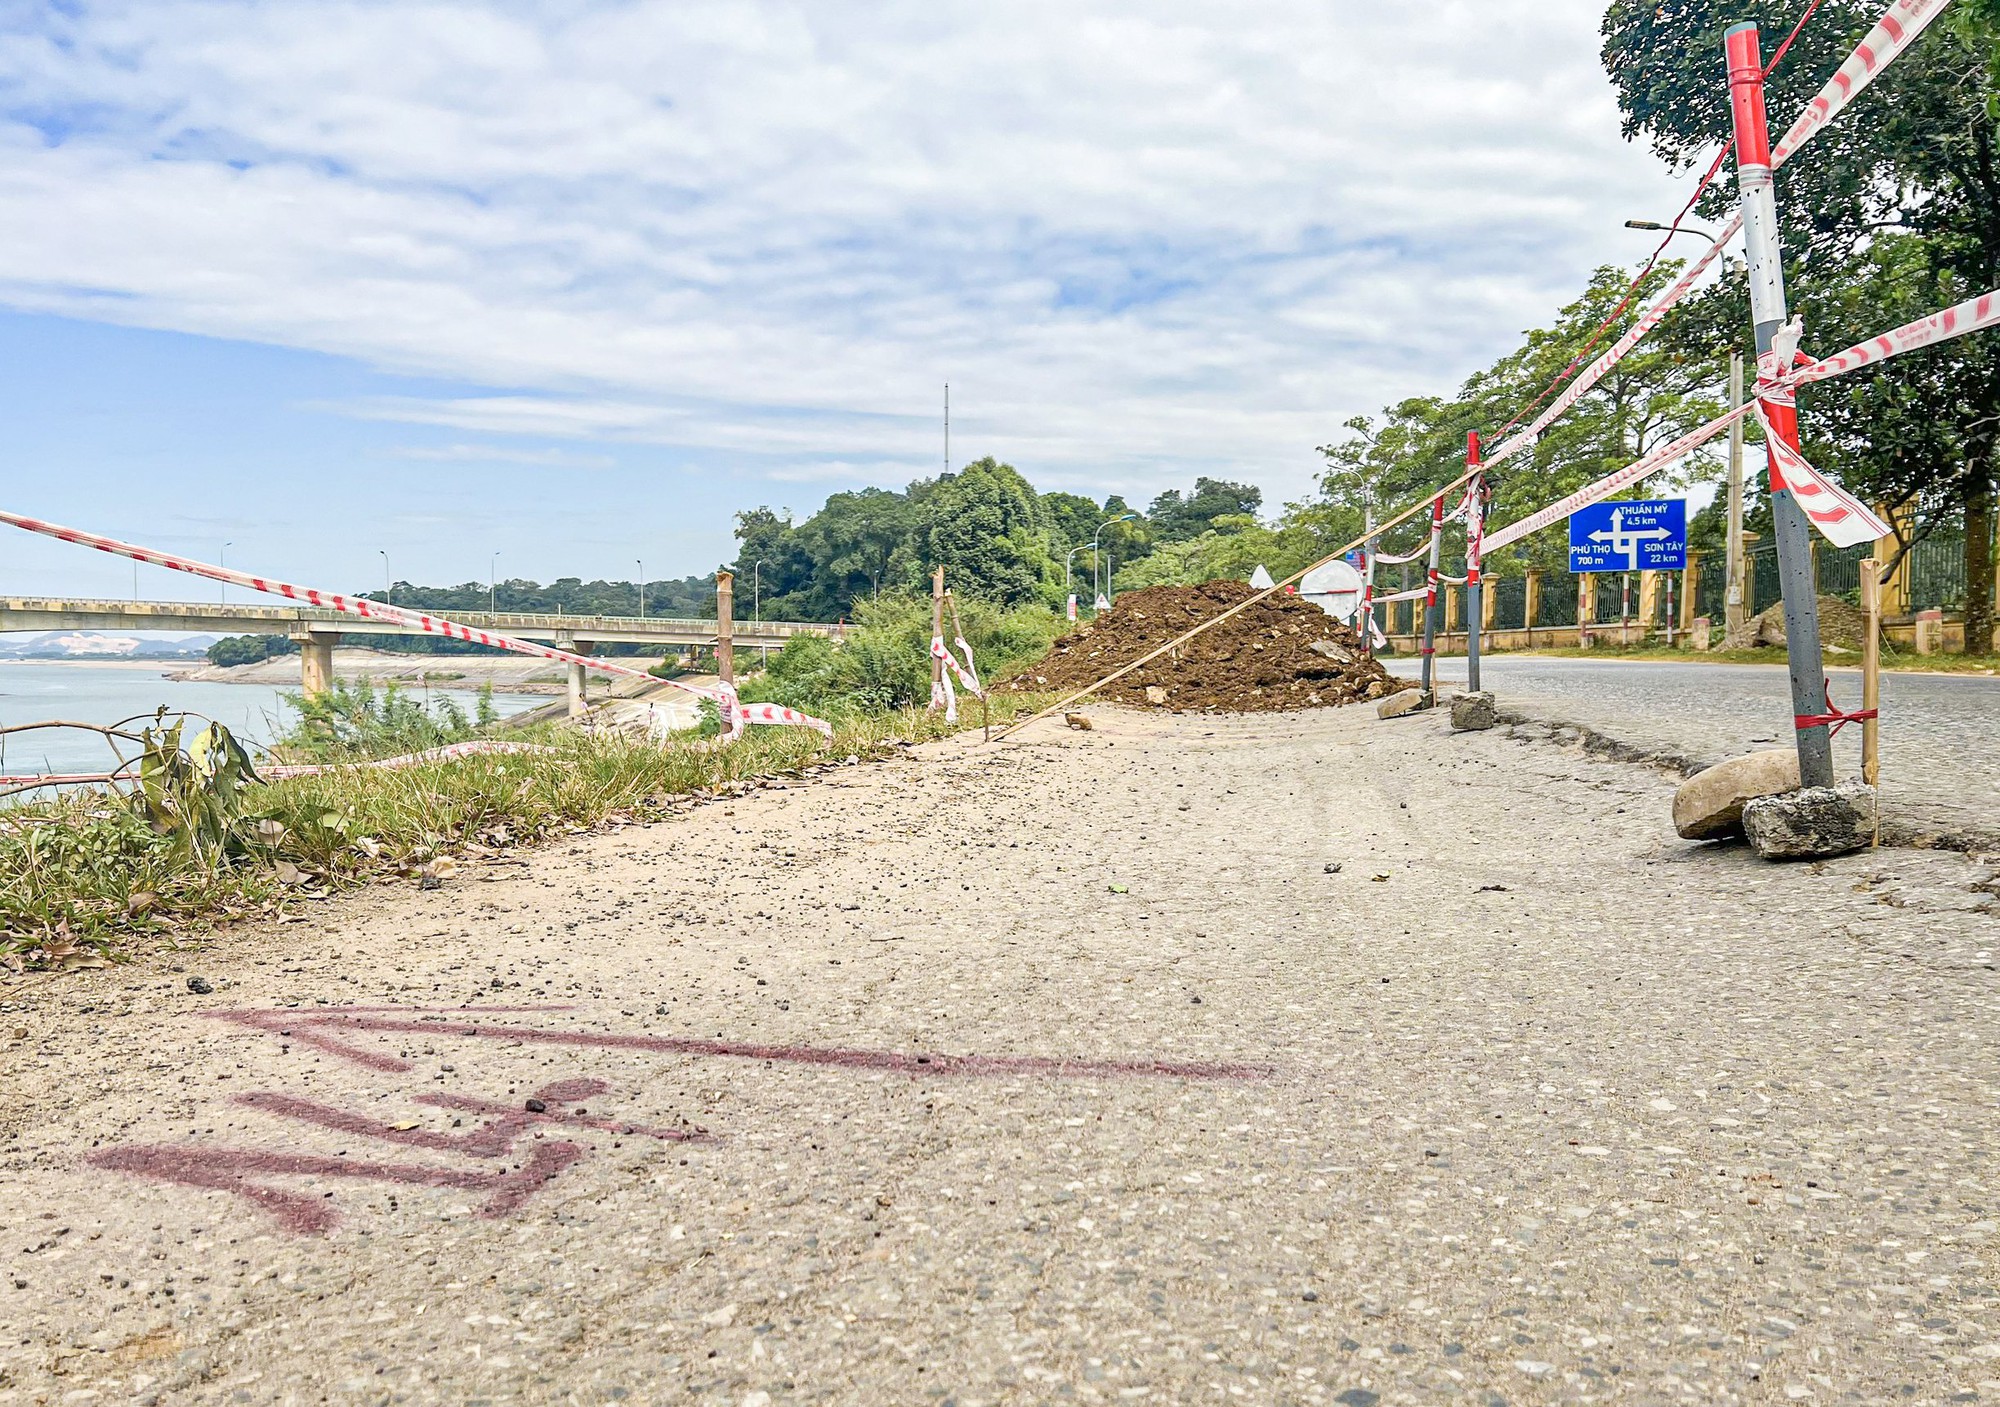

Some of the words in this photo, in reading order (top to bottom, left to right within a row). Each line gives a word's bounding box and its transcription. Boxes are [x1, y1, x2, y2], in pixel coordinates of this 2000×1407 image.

[1654, 503, 1669, 513] MỸ
[1627, 517, 1640, 525] 4.5
[1571, 543, 1590, 555] PHÚ
[1592, 545, 1611, 555] THỌ
[1644, 543, 1664, 552] SƠN
[1666, 541, 1684, 551] TÂY
[1577, 557, 1593, 565] 700
[1650, 554, 1661, 562] 22
[1663, 554, 1678, 562] km
